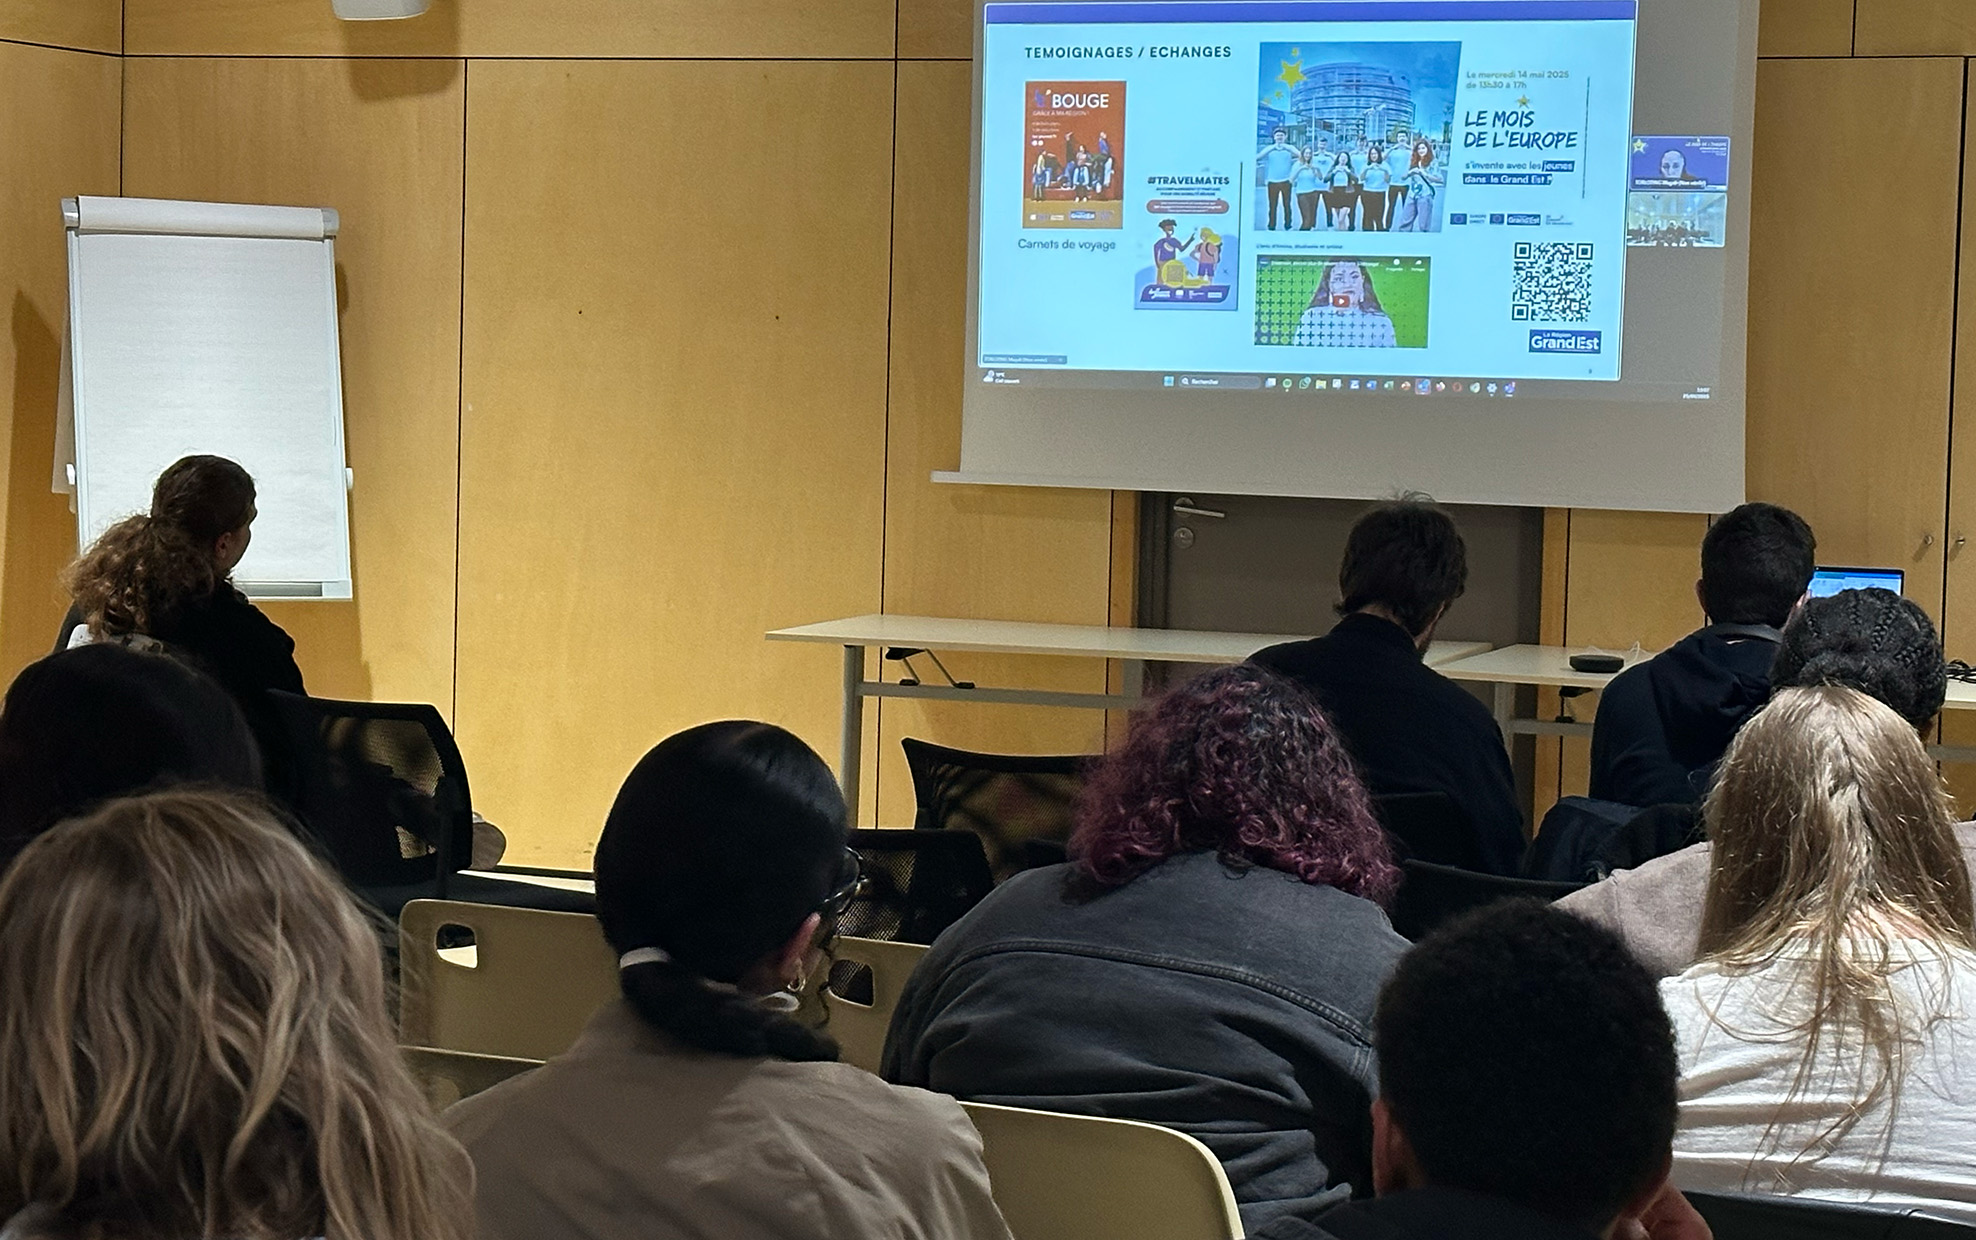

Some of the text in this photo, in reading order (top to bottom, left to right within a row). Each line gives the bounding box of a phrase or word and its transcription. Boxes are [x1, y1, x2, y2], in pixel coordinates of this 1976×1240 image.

[1025, 46, 1232, 59] TEMOIGNAGES / ECHANGES
[1466, 71, 1476, 79] Le
[1478, 70, 1516, 79] mercredi
[1529, 71, 1545, 79] mai
[1547, 71, 1570, 79] 2025
[1466, 81, 1476, 89] de
[1479, 81, 1504, 89] 13h30
[1513, 81, 1527, 89] 17h
[1464, 110, 1535, 128] LE MOIS
[1464, 130, 1578, 150] DE L'EUROPE
[1465, 161, 1573, 172] s'invente avec les jeunes
[1147, 176, 1230, 185] #TRAVELMATES
[1464, 175, 1487, 184] dans
[1490, 175, 1499, 184] le
[1500, 175, 1529, 184] Grand
[1018, 239, 1116, 253] Carnets de voyage
